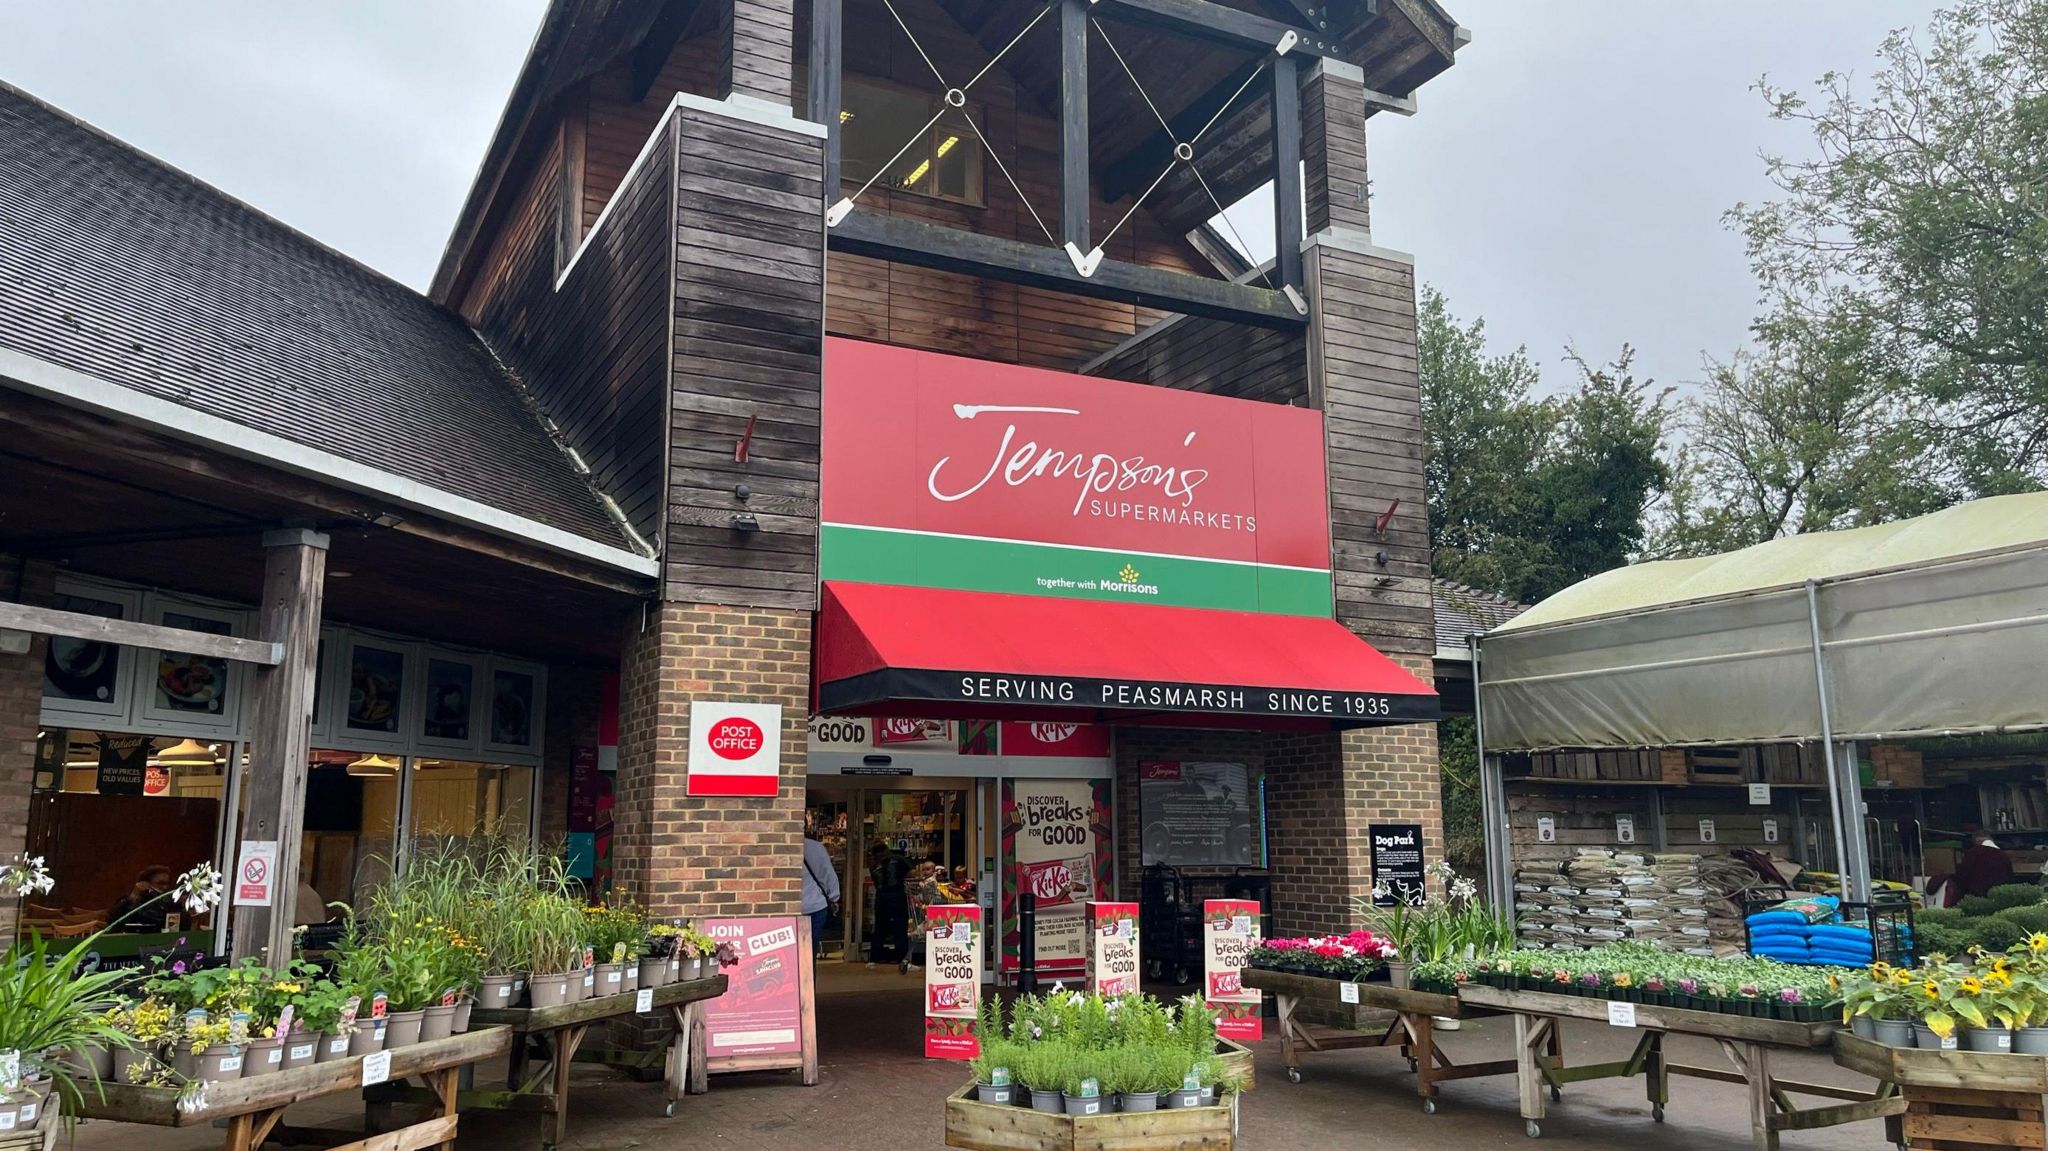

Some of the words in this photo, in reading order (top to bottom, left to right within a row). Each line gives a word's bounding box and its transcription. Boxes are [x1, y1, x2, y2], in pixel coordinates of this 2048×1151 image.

[928, 403, 1209, 517] Jempson's
[1090, 500, 1258, 533] SUPERMARKETS
[1037, 576, 1076, 590] together
[1077, 578, 1097, 591] with
[1100, 579, 1159, 596] Morrisons
[961, 677, 1075, 702] SERVING
[1101, 684, 1244, 710] PEASMARSH
[1268, 691, 1333, 715] SINCE
[1343, 696, 1390, 717] 1935
[720, 725, 754, 738] POST
[808, 725, 817, 733] OR
[818, 723, 866, 744] GOOD
[713, 737, 757, 750] OFFICE
[117, 775, 141, 783] VALUES
[1027, 796, 1065, 805] DISCOVER
[1027, 800, 1084, 826] breaks
[1028, 829, 1042, 837] FOR
[1043, 825, 1087, 846] GOOD
[1375, 835, 1393, 847] Dog
[1394, 834, 1414, 845] Park
[1036, 867, 1071, 897] KitKat
[708, 925, 744, 937] JOIN
[751, 930, 792, 950] CLUB!
[934, 946, 960, 954] DISCOVER
[1104, 946, 1134, 962] breaks
[1215, 941, 1252, 956] breaks
[935, 950, 972, 966] breaks
[1224, 955, 1248, 967] GOO
[944, 965, 973, 980] GOOD
[1112, 961, 1135, 974] GOOD
